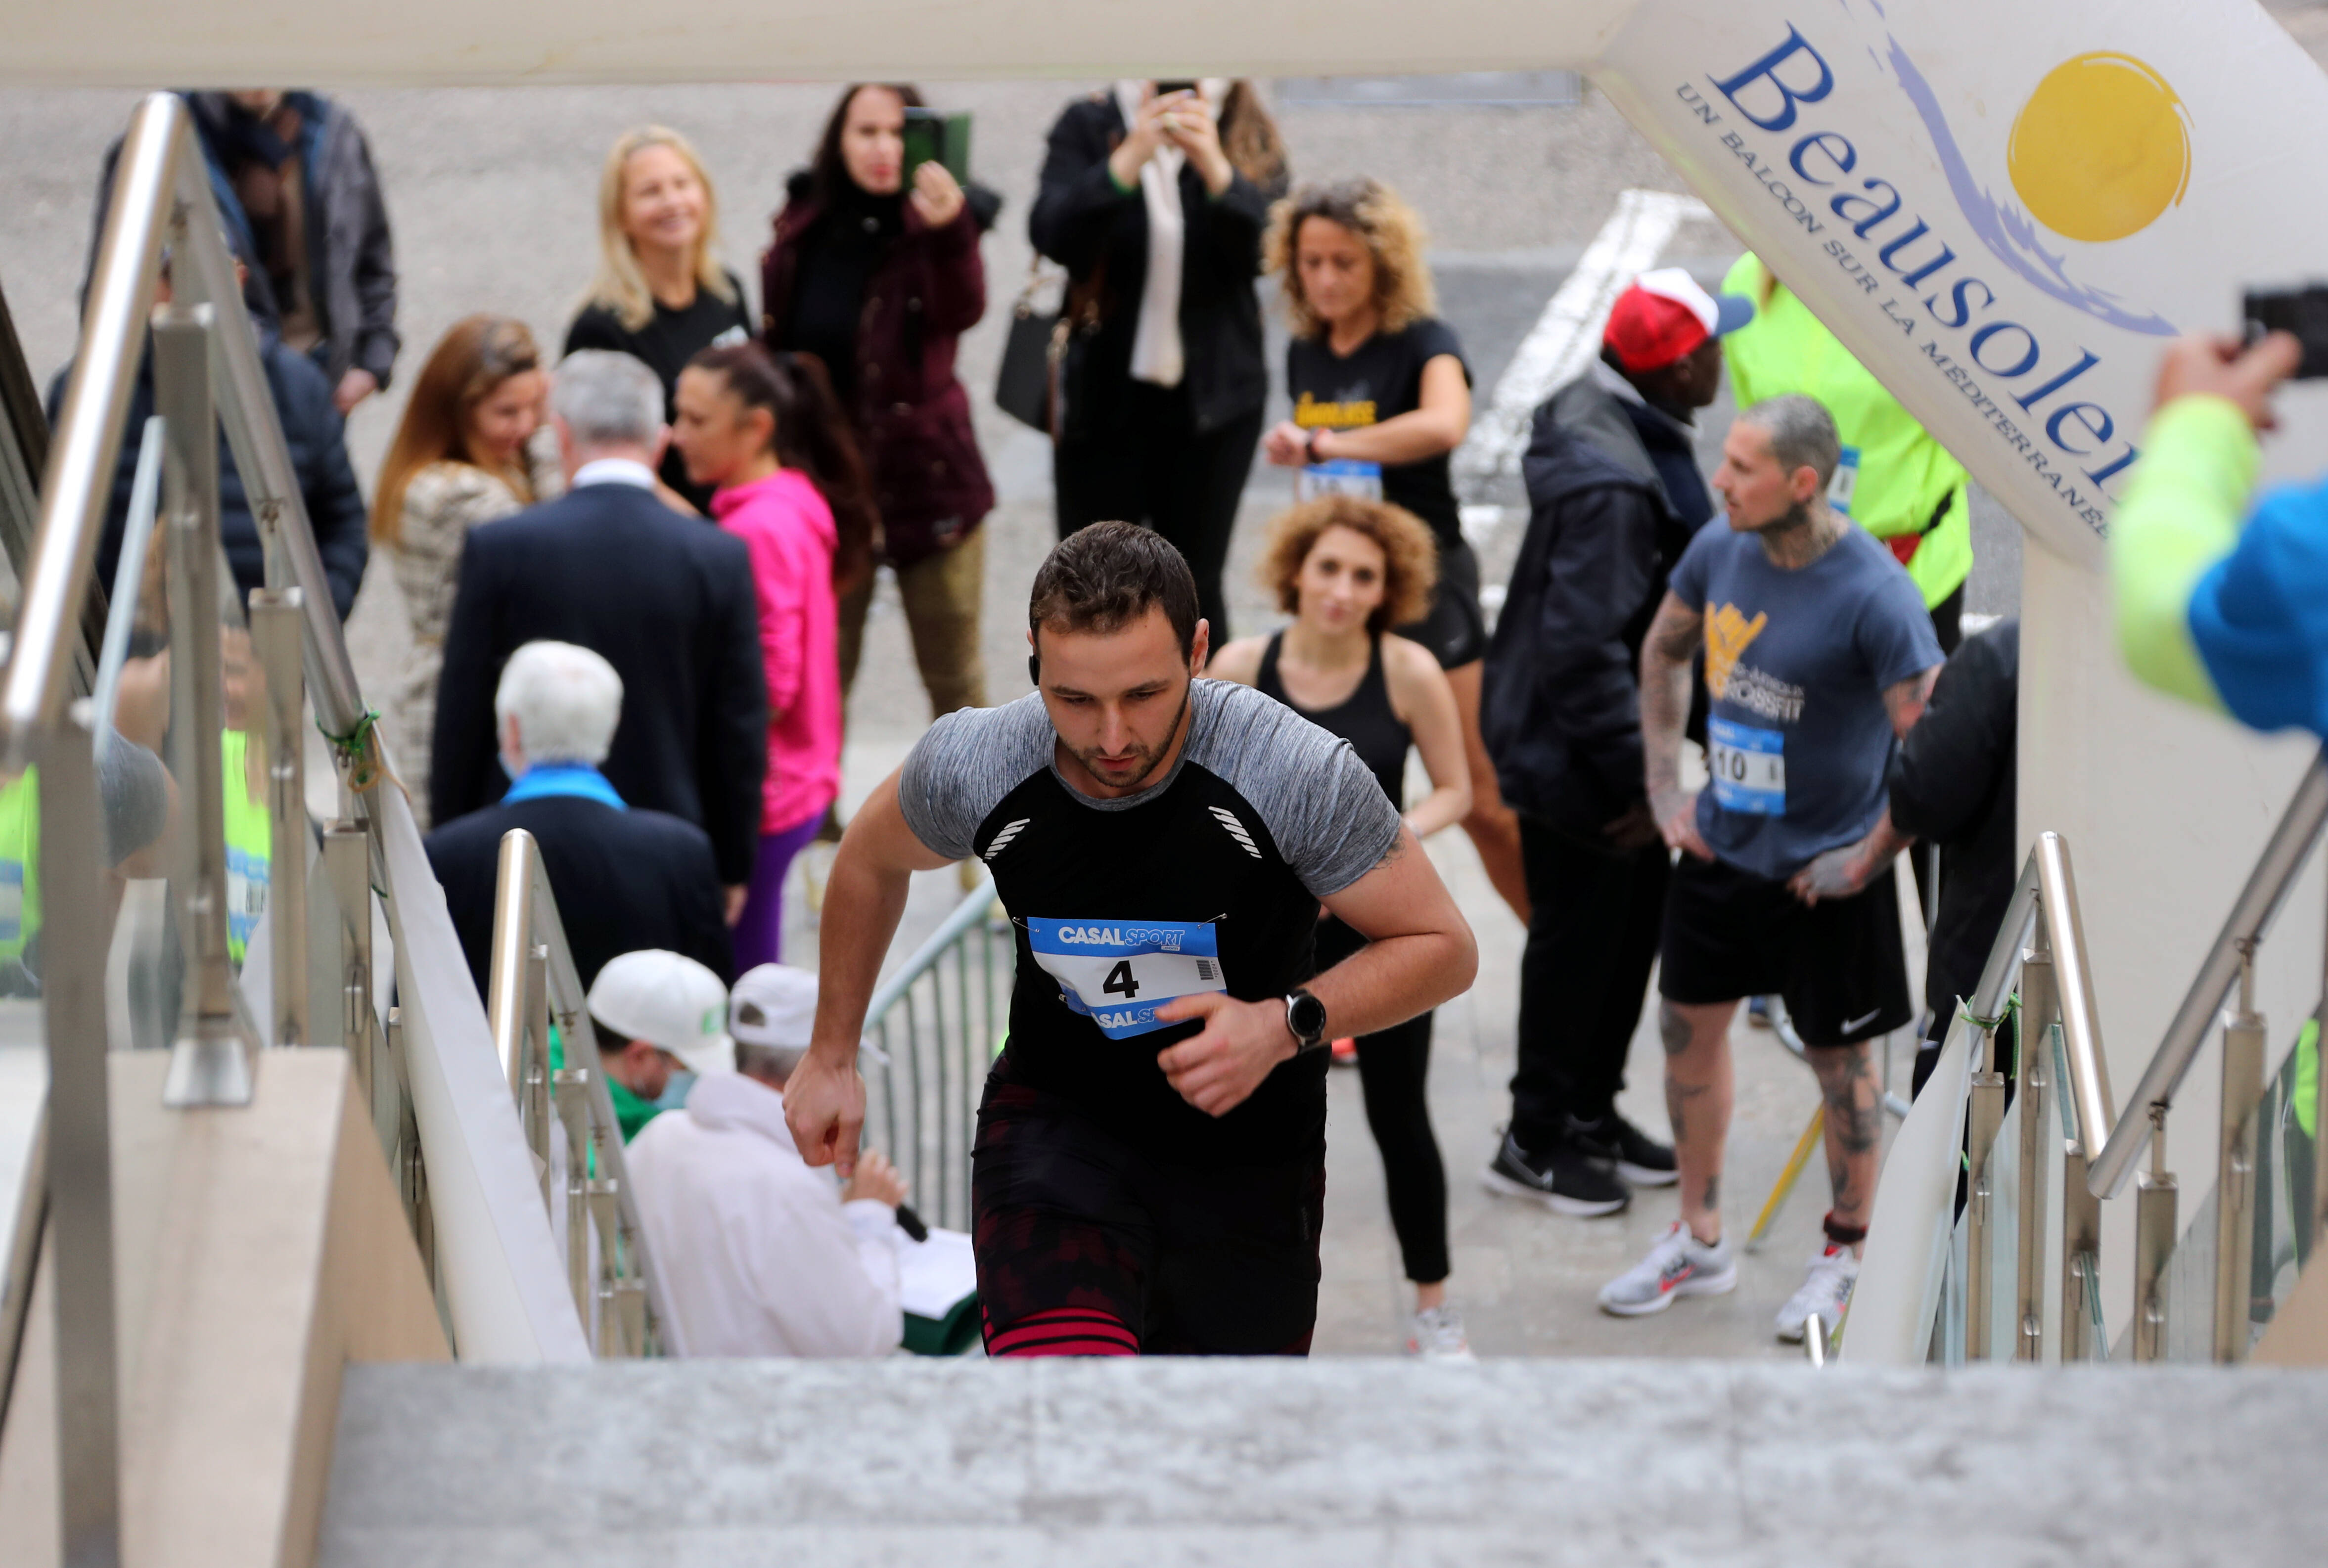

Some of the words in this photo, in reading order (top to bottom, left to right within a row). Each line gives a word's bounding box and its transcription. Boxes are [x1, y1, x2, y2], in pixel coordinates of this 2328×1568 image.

[1676, 82, 1723, 125] UN
[1720, 130, 1826, 235] BALCON
[1822, 239, 1879, 295] SUR
[1880, 297, 1917, 336] LA
[1705, 20, 2143, 507] Beausolei
[1717, 751, 1746, 781] 10
[1102, 960, 1139, 998] 4
